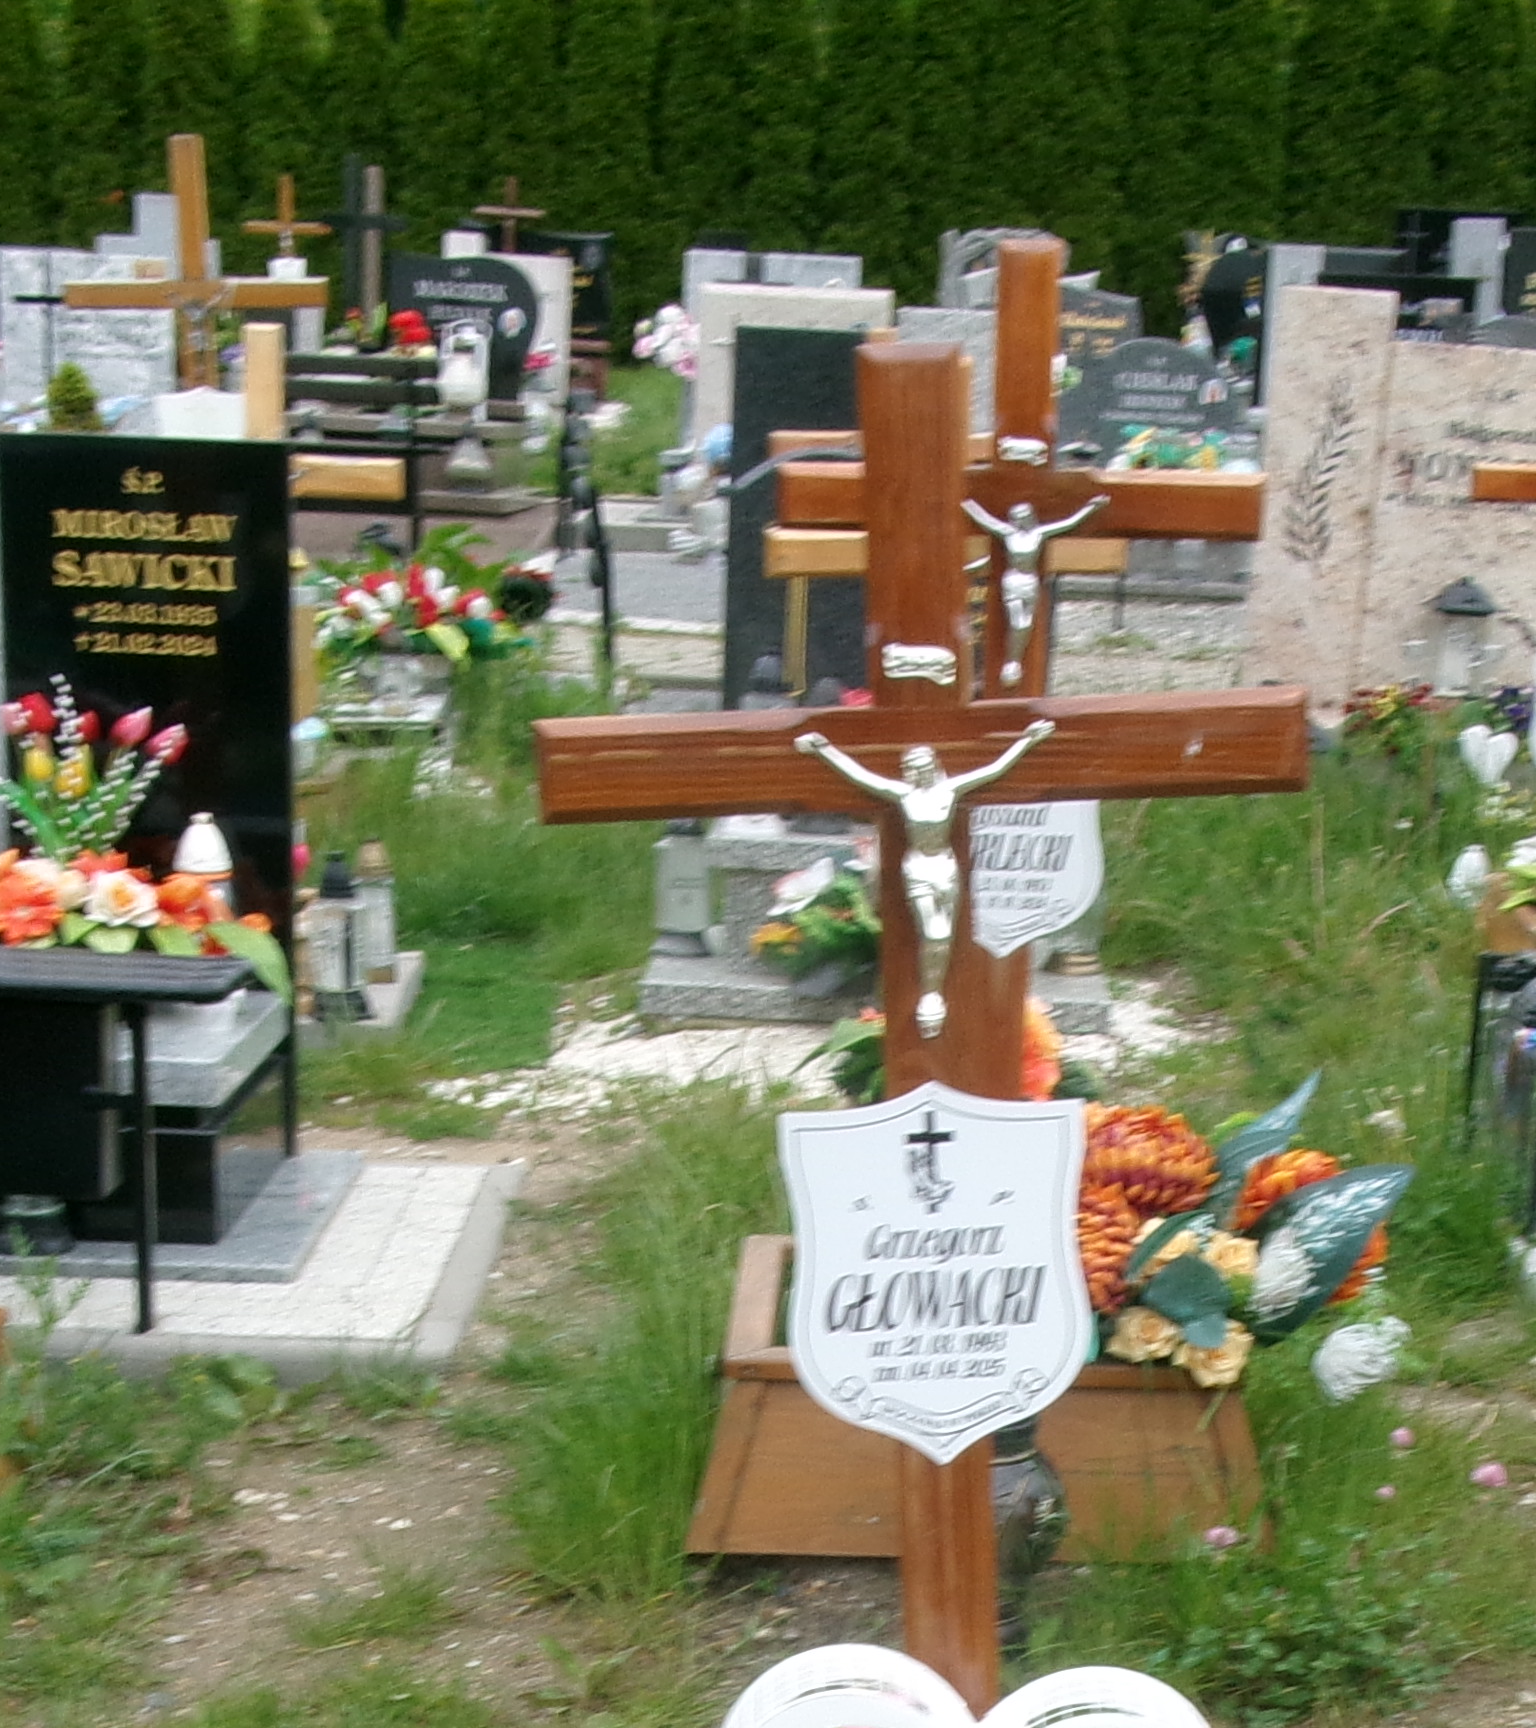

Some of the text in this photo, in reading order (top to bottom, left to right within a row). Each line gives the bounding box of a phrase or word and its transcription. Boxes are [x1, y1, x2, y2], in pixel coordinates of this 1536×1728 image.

[50, 508, 239, 542] MIROSŁAW
[50, 549, 238, 592] SAWICKI
[865, 1224, 1005, 1266] Grzegorz
[825, 1264, 1048, 1334] GŁOWACKI
